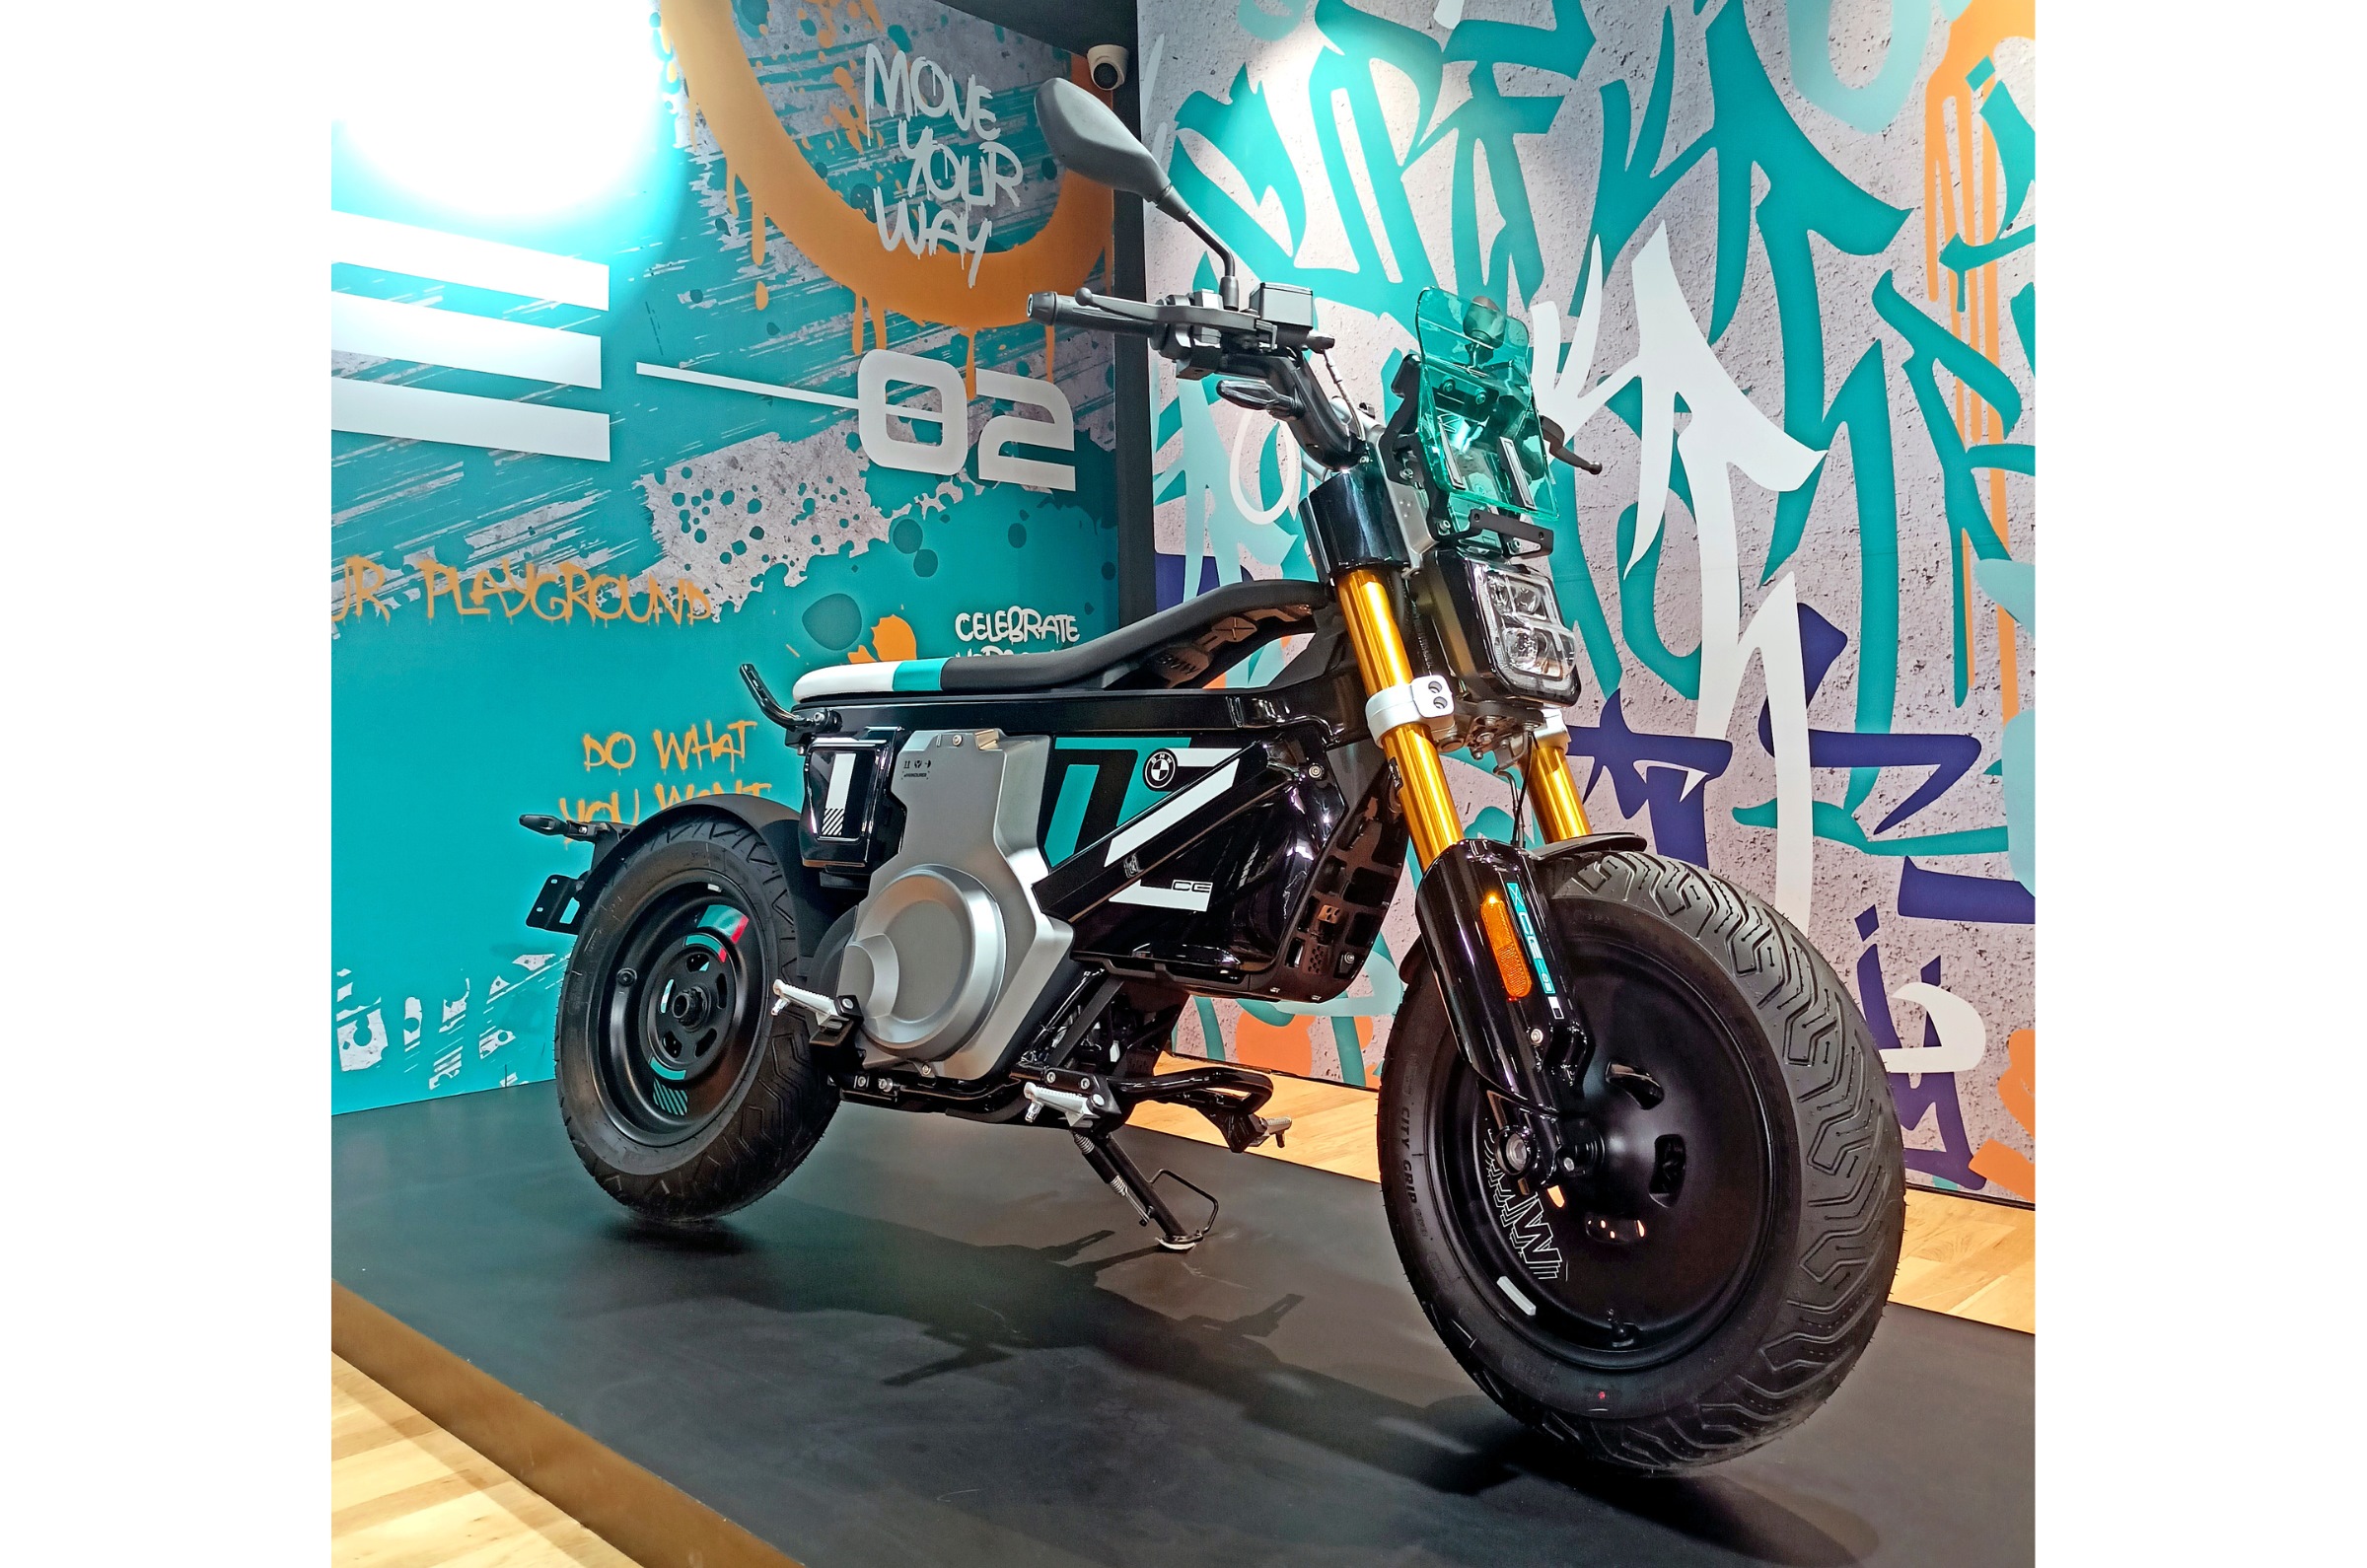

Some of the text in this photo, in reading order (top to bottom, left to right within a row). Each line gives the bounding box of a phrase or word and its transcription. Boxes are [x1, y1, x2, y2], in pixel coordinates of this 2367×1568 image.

[864, 43, 1001, 146] MOVE
[897, 118, 1024, 208] YOUR
[873, 186, 992, 289] WAY
[857, 348, 1076, 491] 02
[417, 558, 712, 628] PLAYGROUND
[955, 606, 1080, 645] CELEBRATE
[582, 720, 757, 775] DO WHAT
[1172, 881, 1213, 893] CE
[1518, 911, 1543, 960] CE
[1400, 1105, 1410, 1151] CITY
[1401, 1159, 1418, 1204] GRIP
